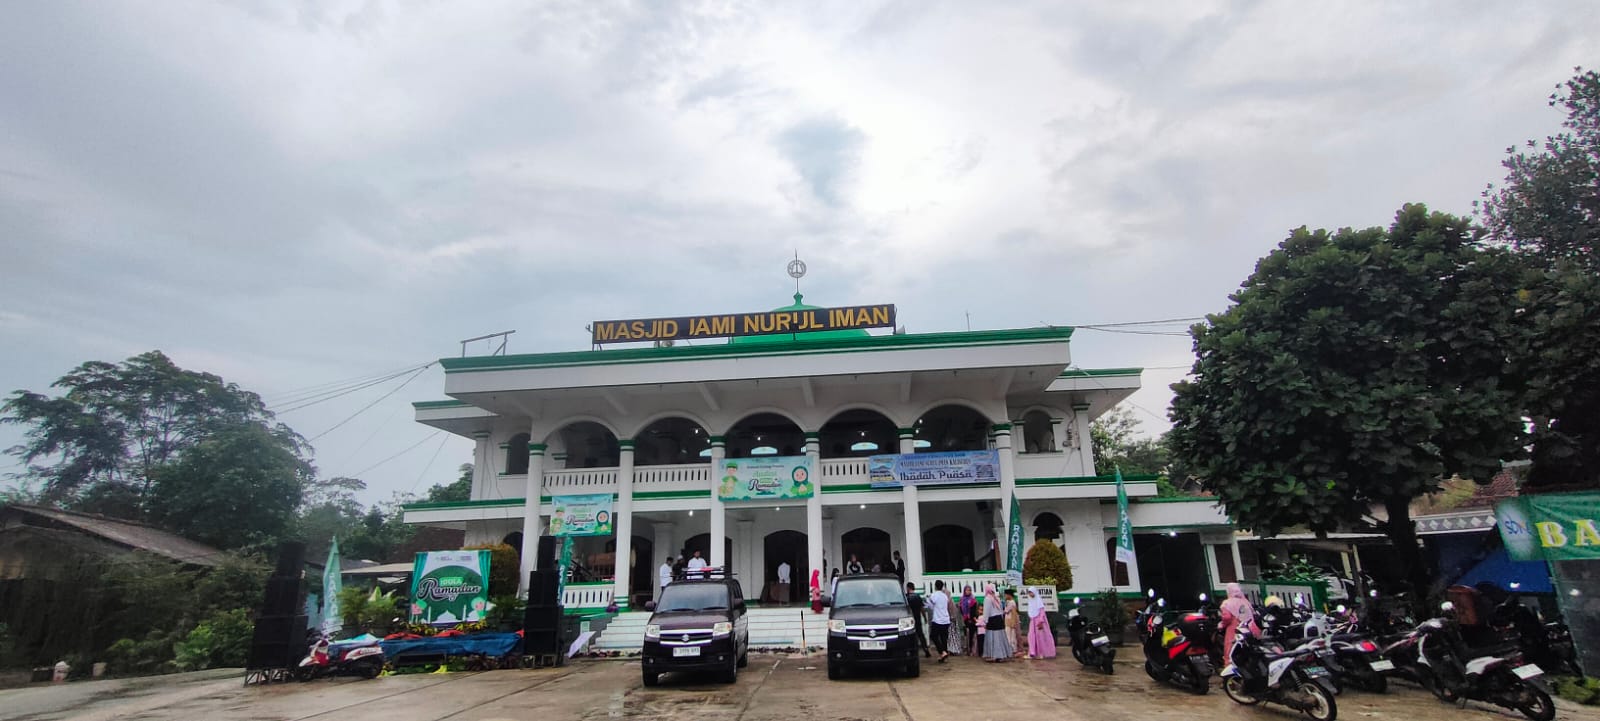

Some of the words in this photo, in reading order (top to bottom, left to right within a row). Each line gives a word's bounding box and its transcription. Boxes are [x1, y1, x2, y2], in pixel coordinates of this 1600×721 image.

[596, 320, 678, 340] MASJID
[829, 306, 889, 328] IMAN
[938, 469, 973, 479] Puasa
[1011, 524, 1020, 569] RAMADAN
[417, 578, 481, 601] Ramadan
